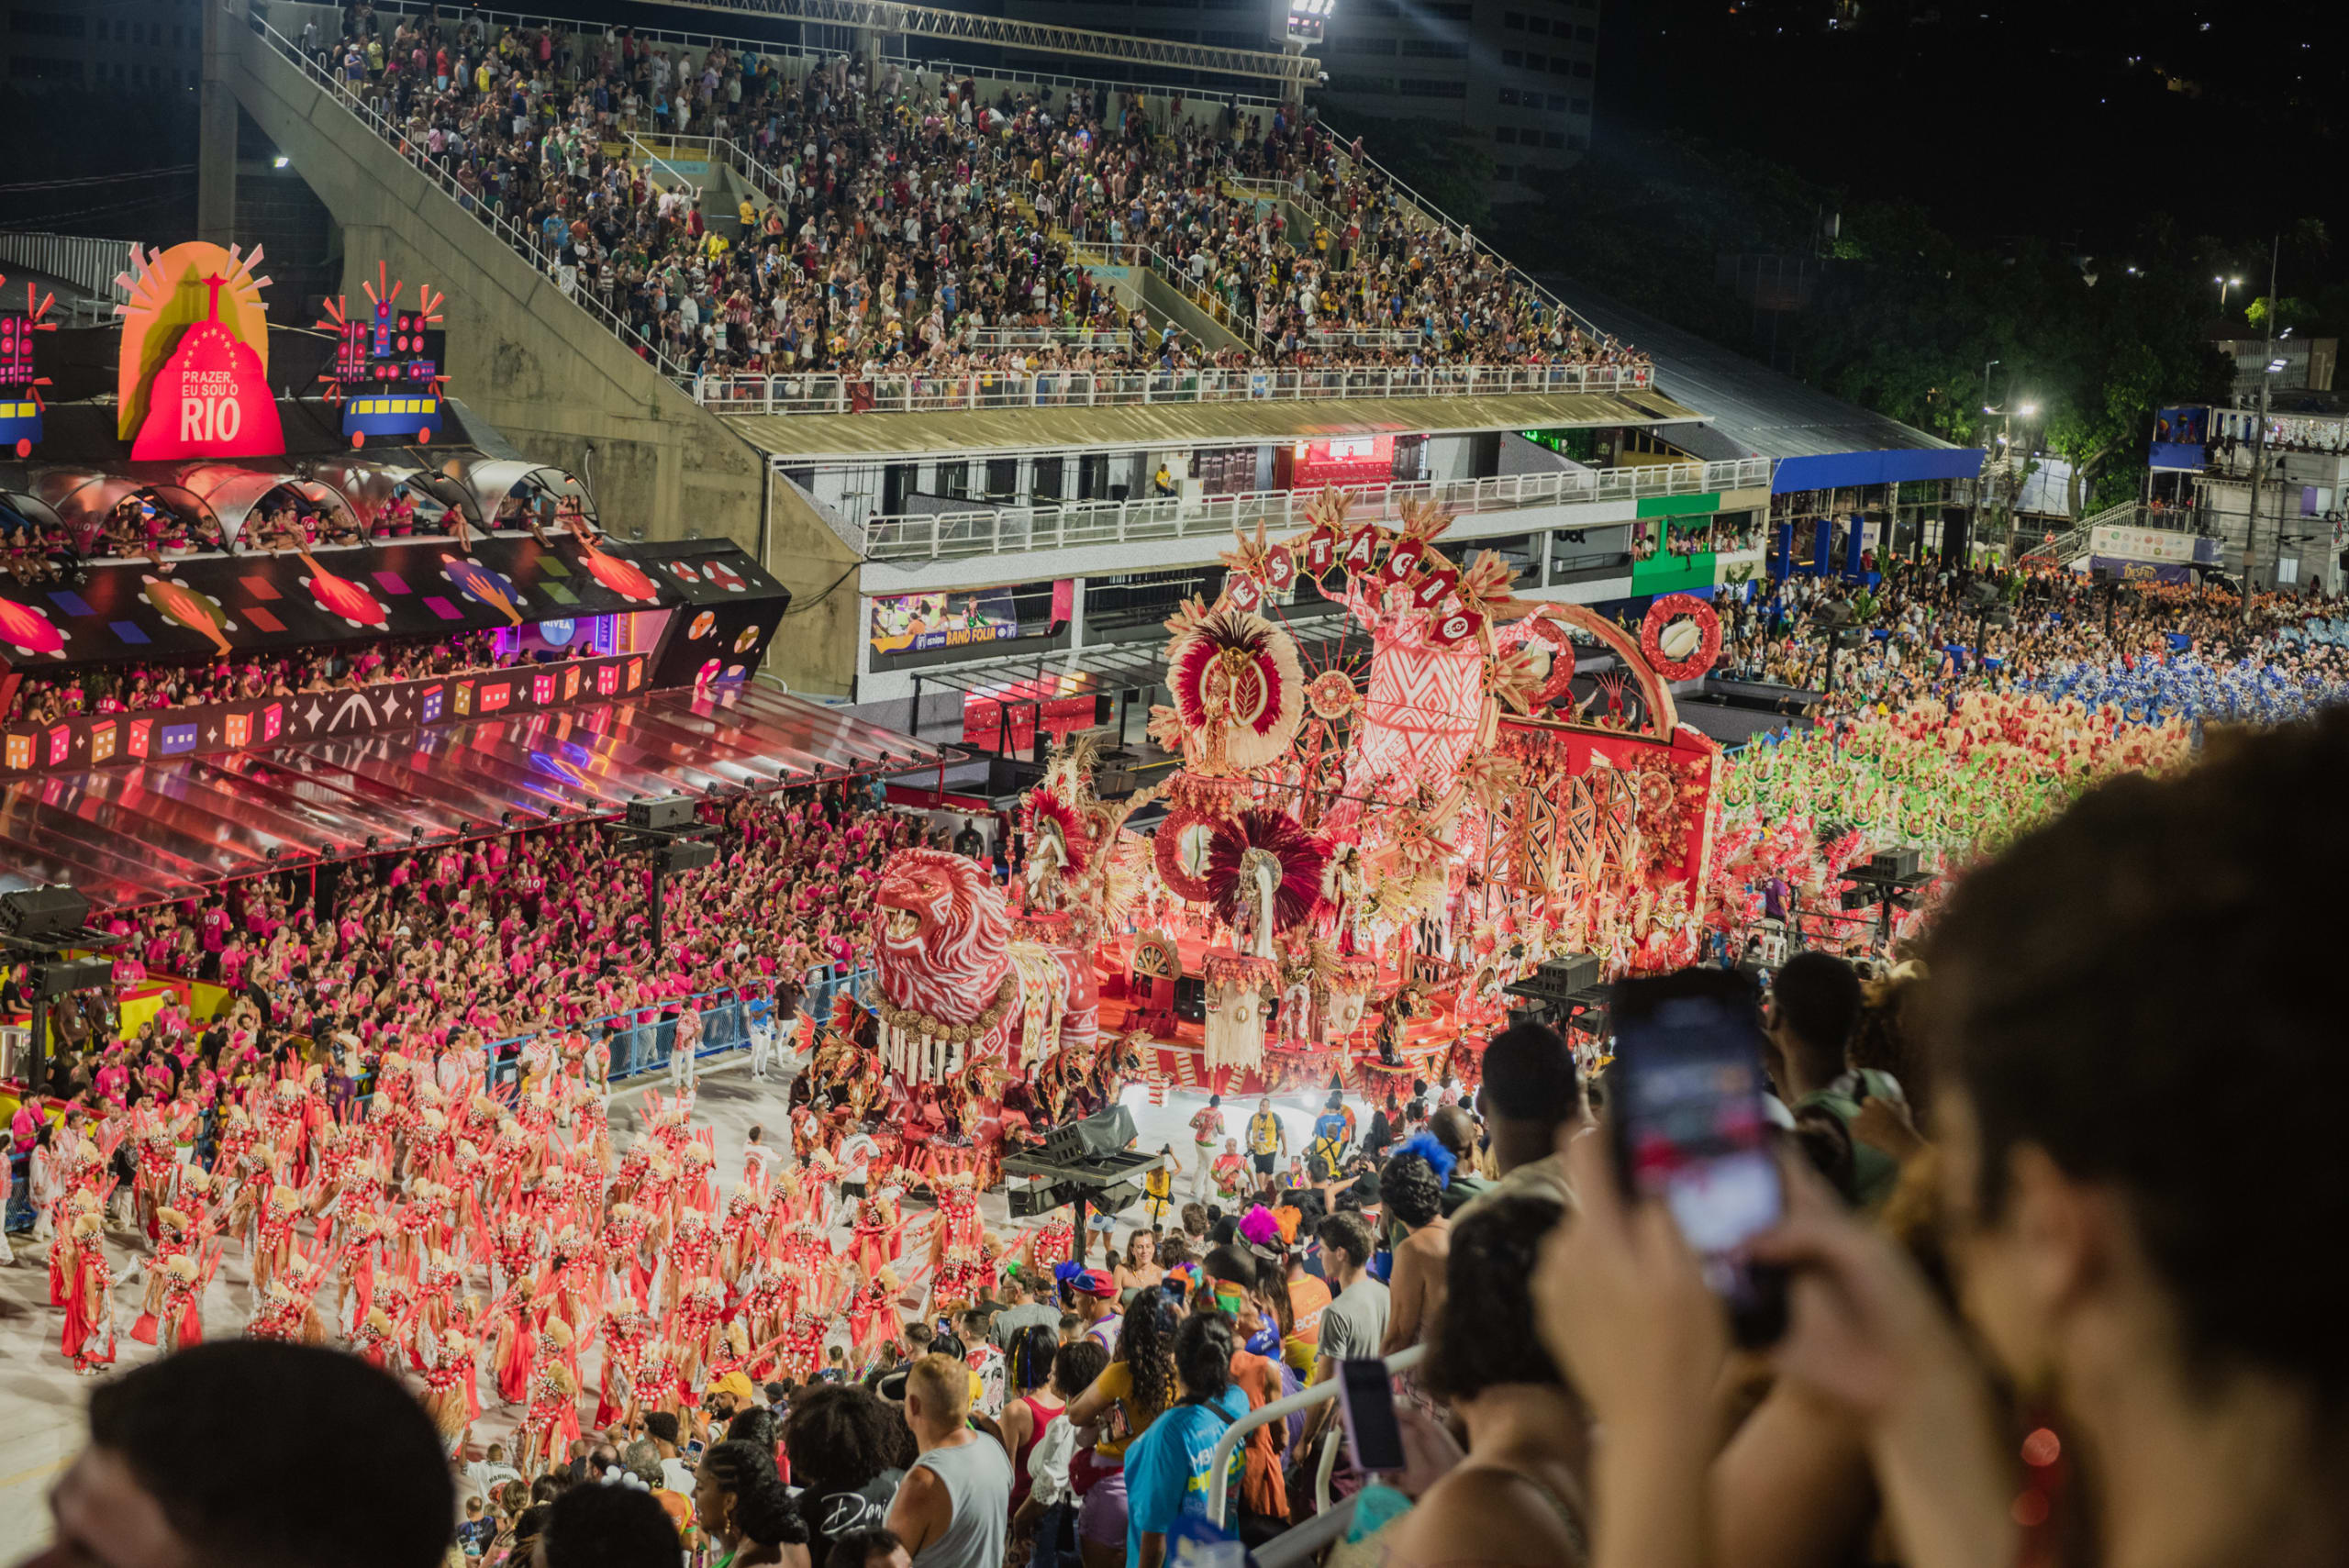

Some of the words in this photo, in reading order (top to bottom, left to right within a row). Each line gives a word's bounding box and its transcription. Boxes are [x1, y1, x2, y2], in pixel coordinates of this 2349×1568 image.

[182, 371, 234, 384] PRAZER,
[182, 384, 198, 396] EU
[201, 384, 227, 396] SOU
[229, 383, 239, 396] O
[180, 396, 241, 441] RIO
[543, 619, 571, 630] NIVEA
[600, 615, 610, 642] NIVE
[946, 628, 971, 646] BAND
[972, 627, 996, 642] FOLIA
